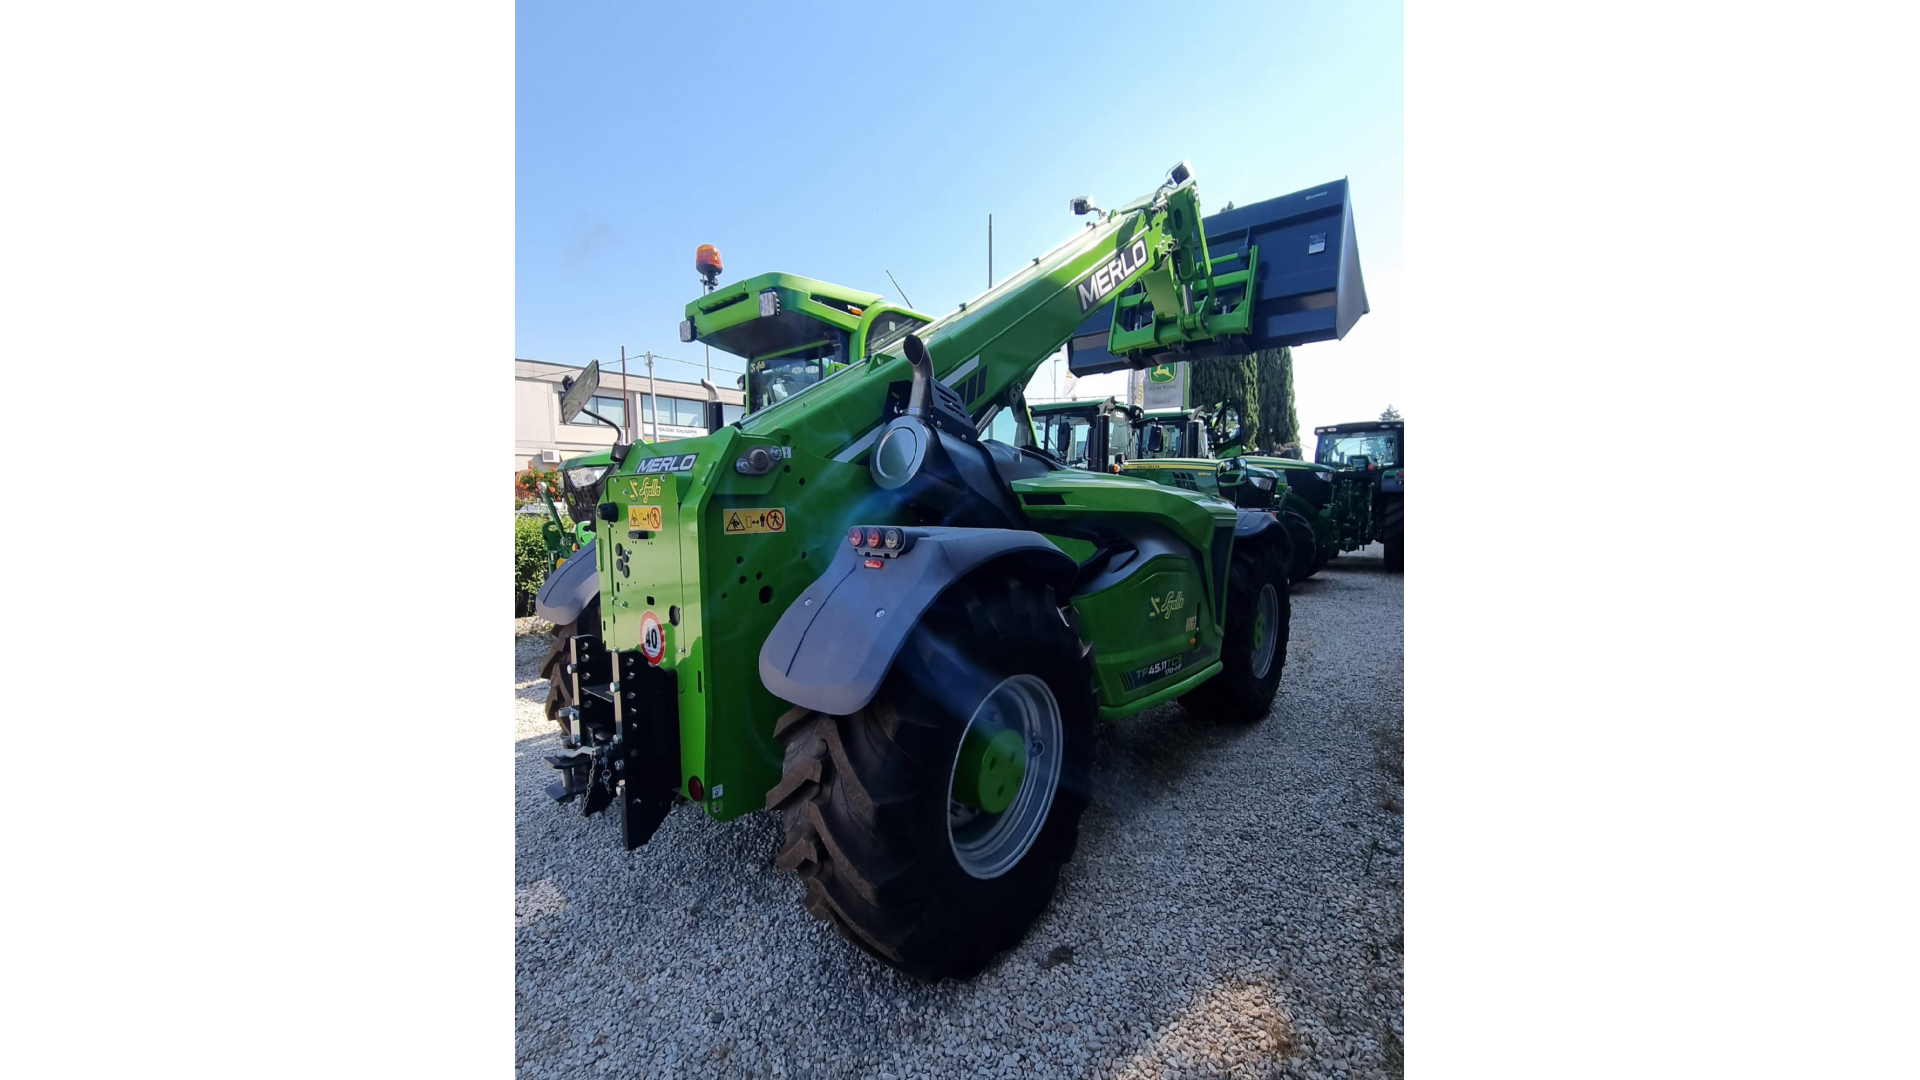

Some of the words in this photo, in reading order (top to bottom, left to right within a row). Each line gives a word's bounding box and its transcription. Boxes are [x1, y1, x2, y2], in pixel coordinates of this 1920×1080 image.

[1078, 240, 1147, 310] MERLO
[636, 454, 697, 473] MERLO
[645, 626, 658, 649] 40
